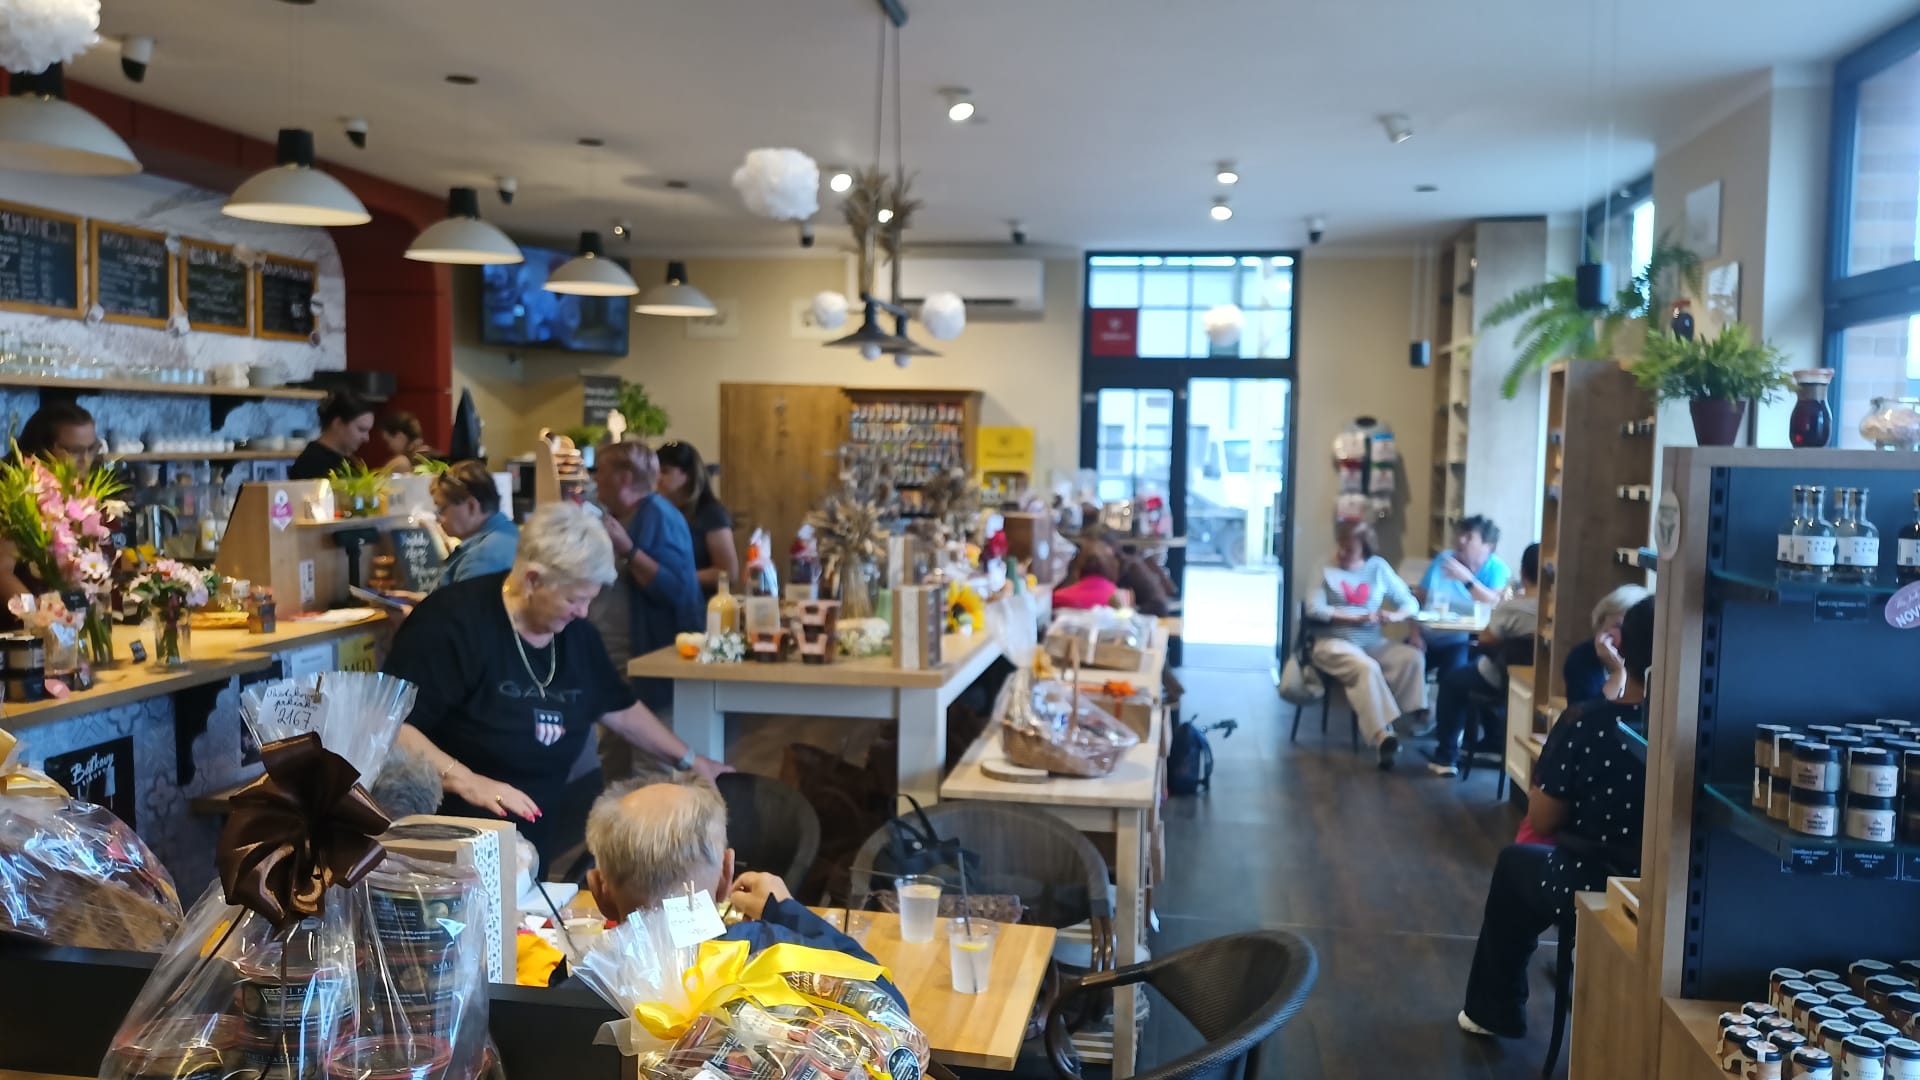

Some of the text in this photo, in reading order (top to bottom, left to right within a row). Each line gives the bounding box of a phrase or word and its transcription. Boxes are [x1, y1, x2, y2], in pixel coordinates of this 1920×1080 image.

[1895, 604, 1920, 628] NOV
[499, 680, 584, 704] GANT
[277, 707, 312, 730] 2167
